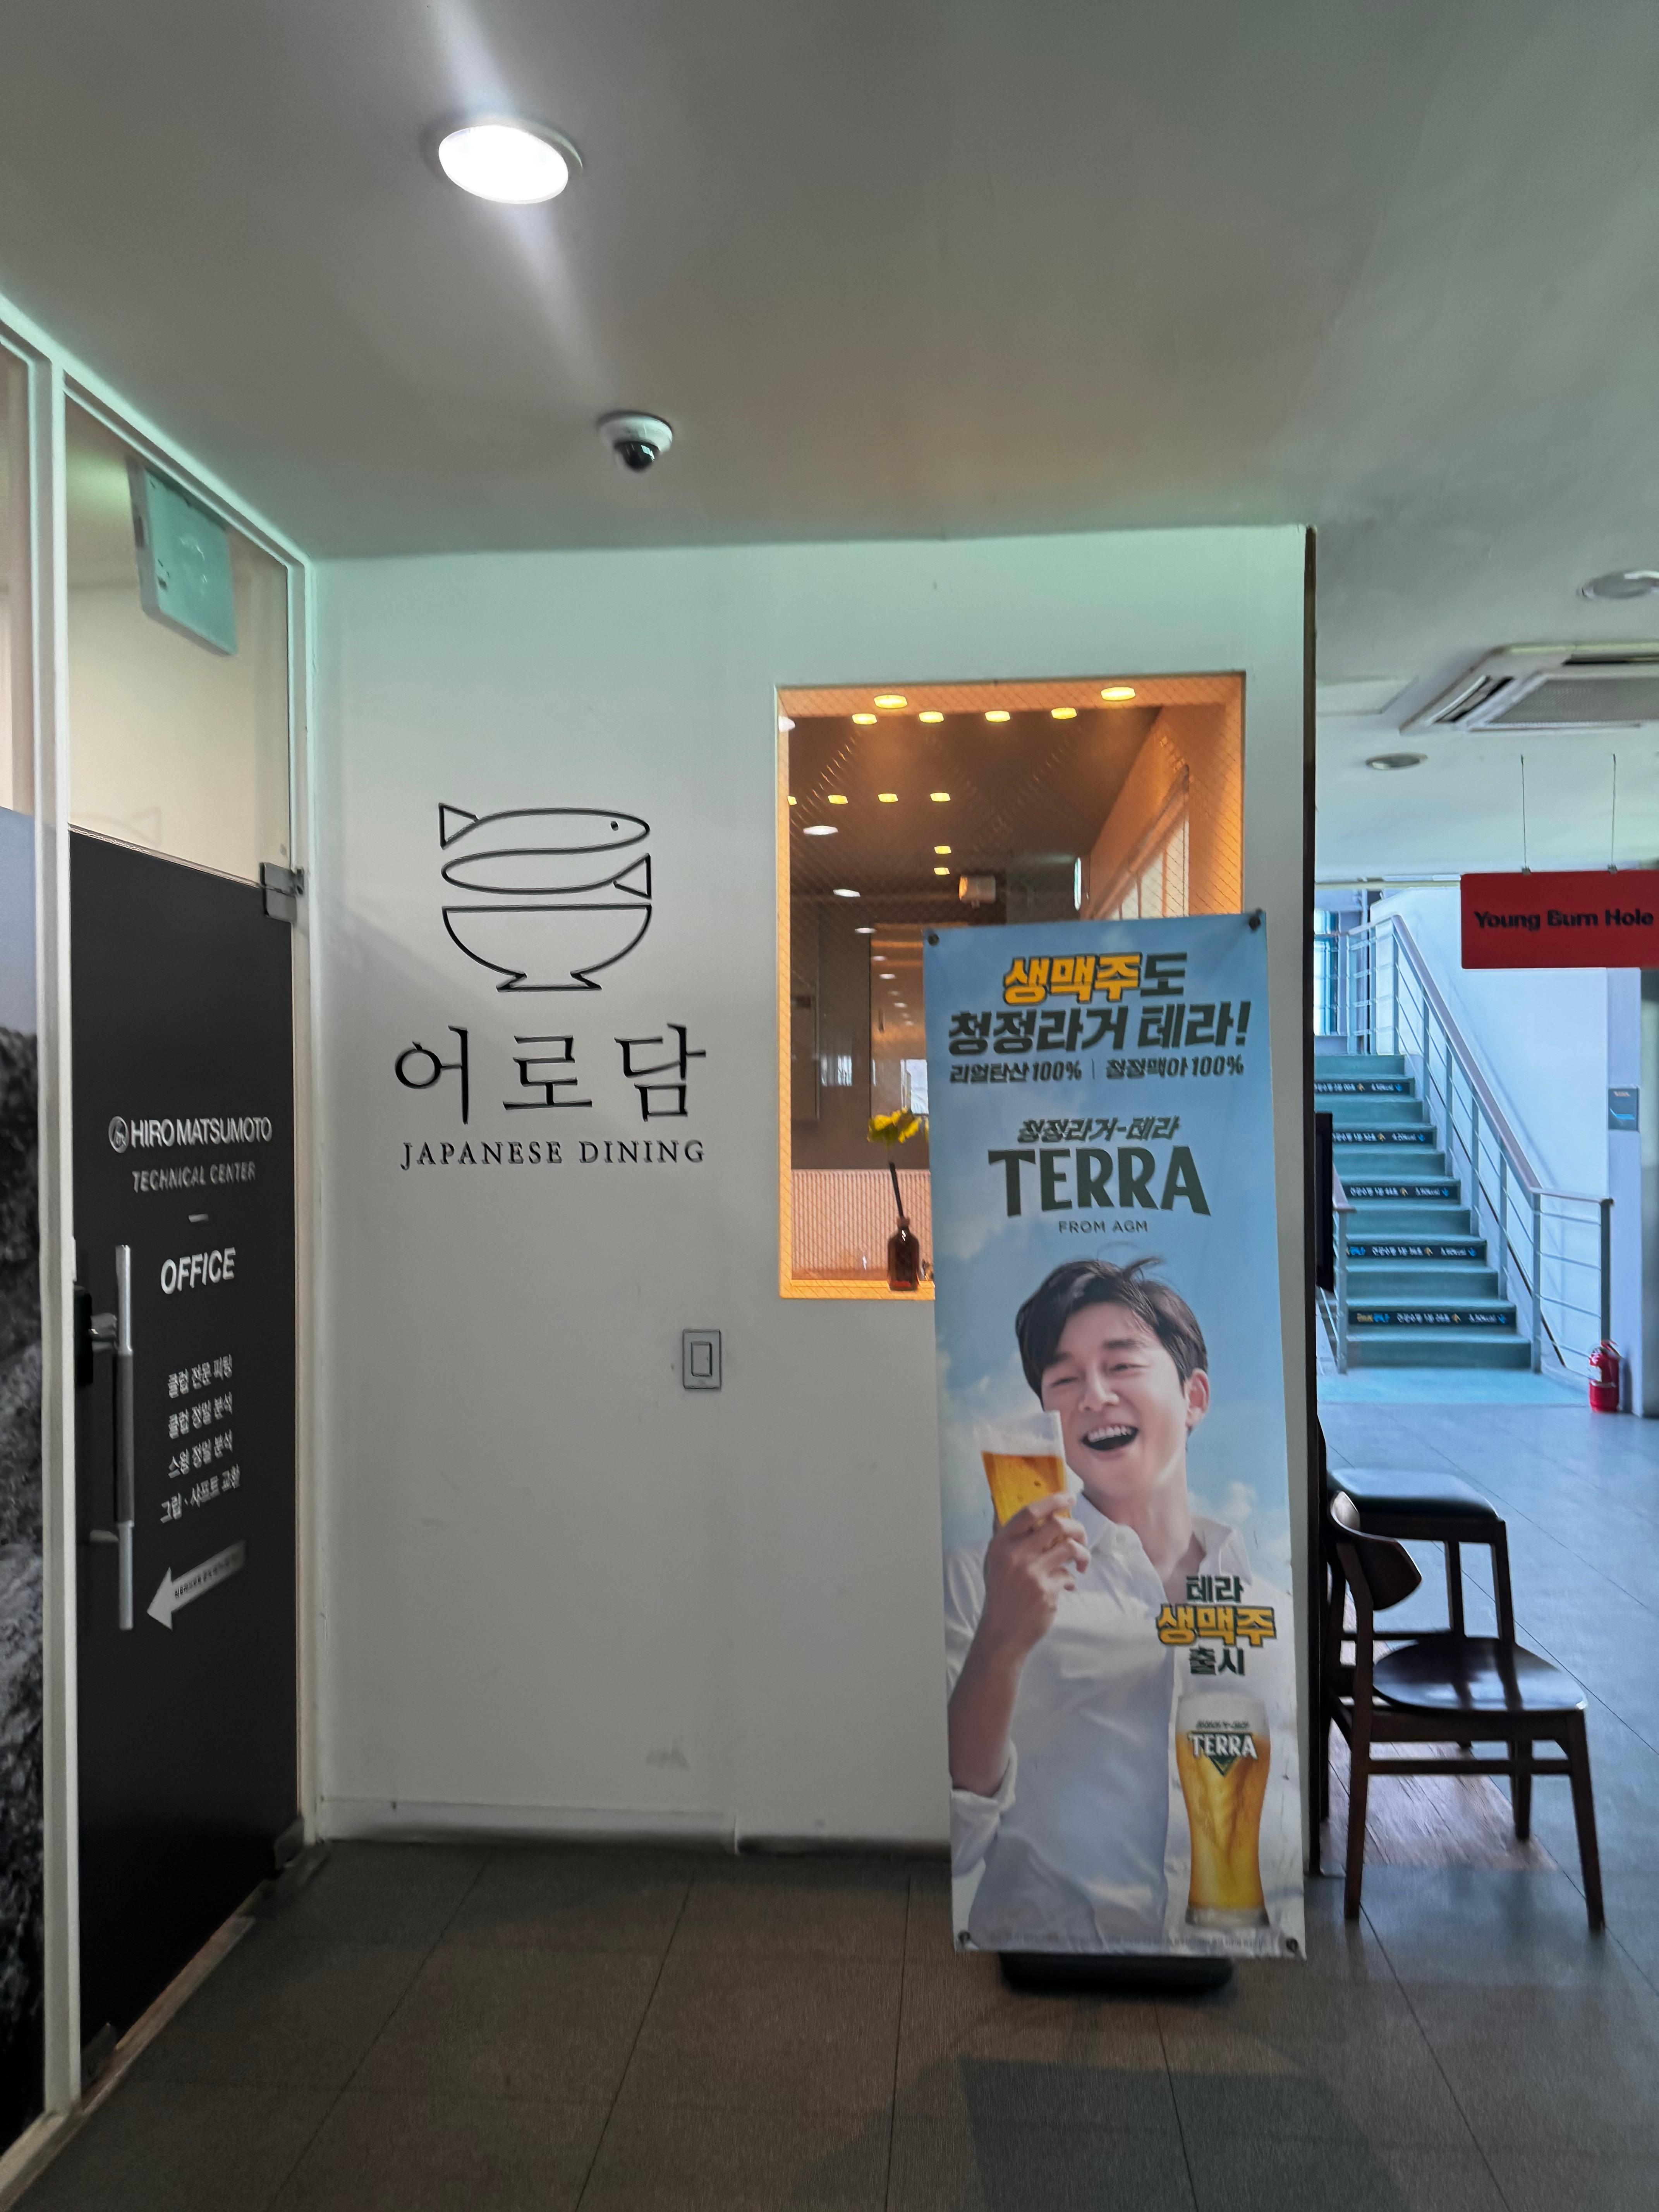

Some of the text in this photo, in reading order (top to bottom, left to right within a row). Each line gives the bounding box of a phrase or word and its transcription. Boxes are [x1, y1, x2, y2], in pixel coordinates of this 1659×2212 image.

[1474, 911, 1540, 932] Young
[1605, 908, 1654, 926] Hole
[1003, 952, 1187, 1006] 생맥주도
[948, 1000, 1252, 1055] 청정라거 테라!
[395, 1023, 706, 1125] 어로담
[400, 1139, 704, 1171] JAPANESE DINING
[132, 1161, 256, 1193] TECHNICAL CENTER
[988, 1145, 1211, 1217] TERRA
[1058, 1219, 1148, 1233] FROM AGM
[161, 1247, 236, 1294] OFFICE
[168, 1369, 189, 1399] 클럽
[192, 1362, 213, 1389] 전문
[168, 1408, 189, 1439] 클럽
[213, 1391, 233, 1420] 분석
[214, 1429, 233, 1458] 분석
[1186, 1574, 1244, 1603] 테라
[1156, 1603, 1277, 1647] 생맥주
[1189, 1645, 1245, 1675] 출시
[1188, 1732, 1258, 1760] TERRA
